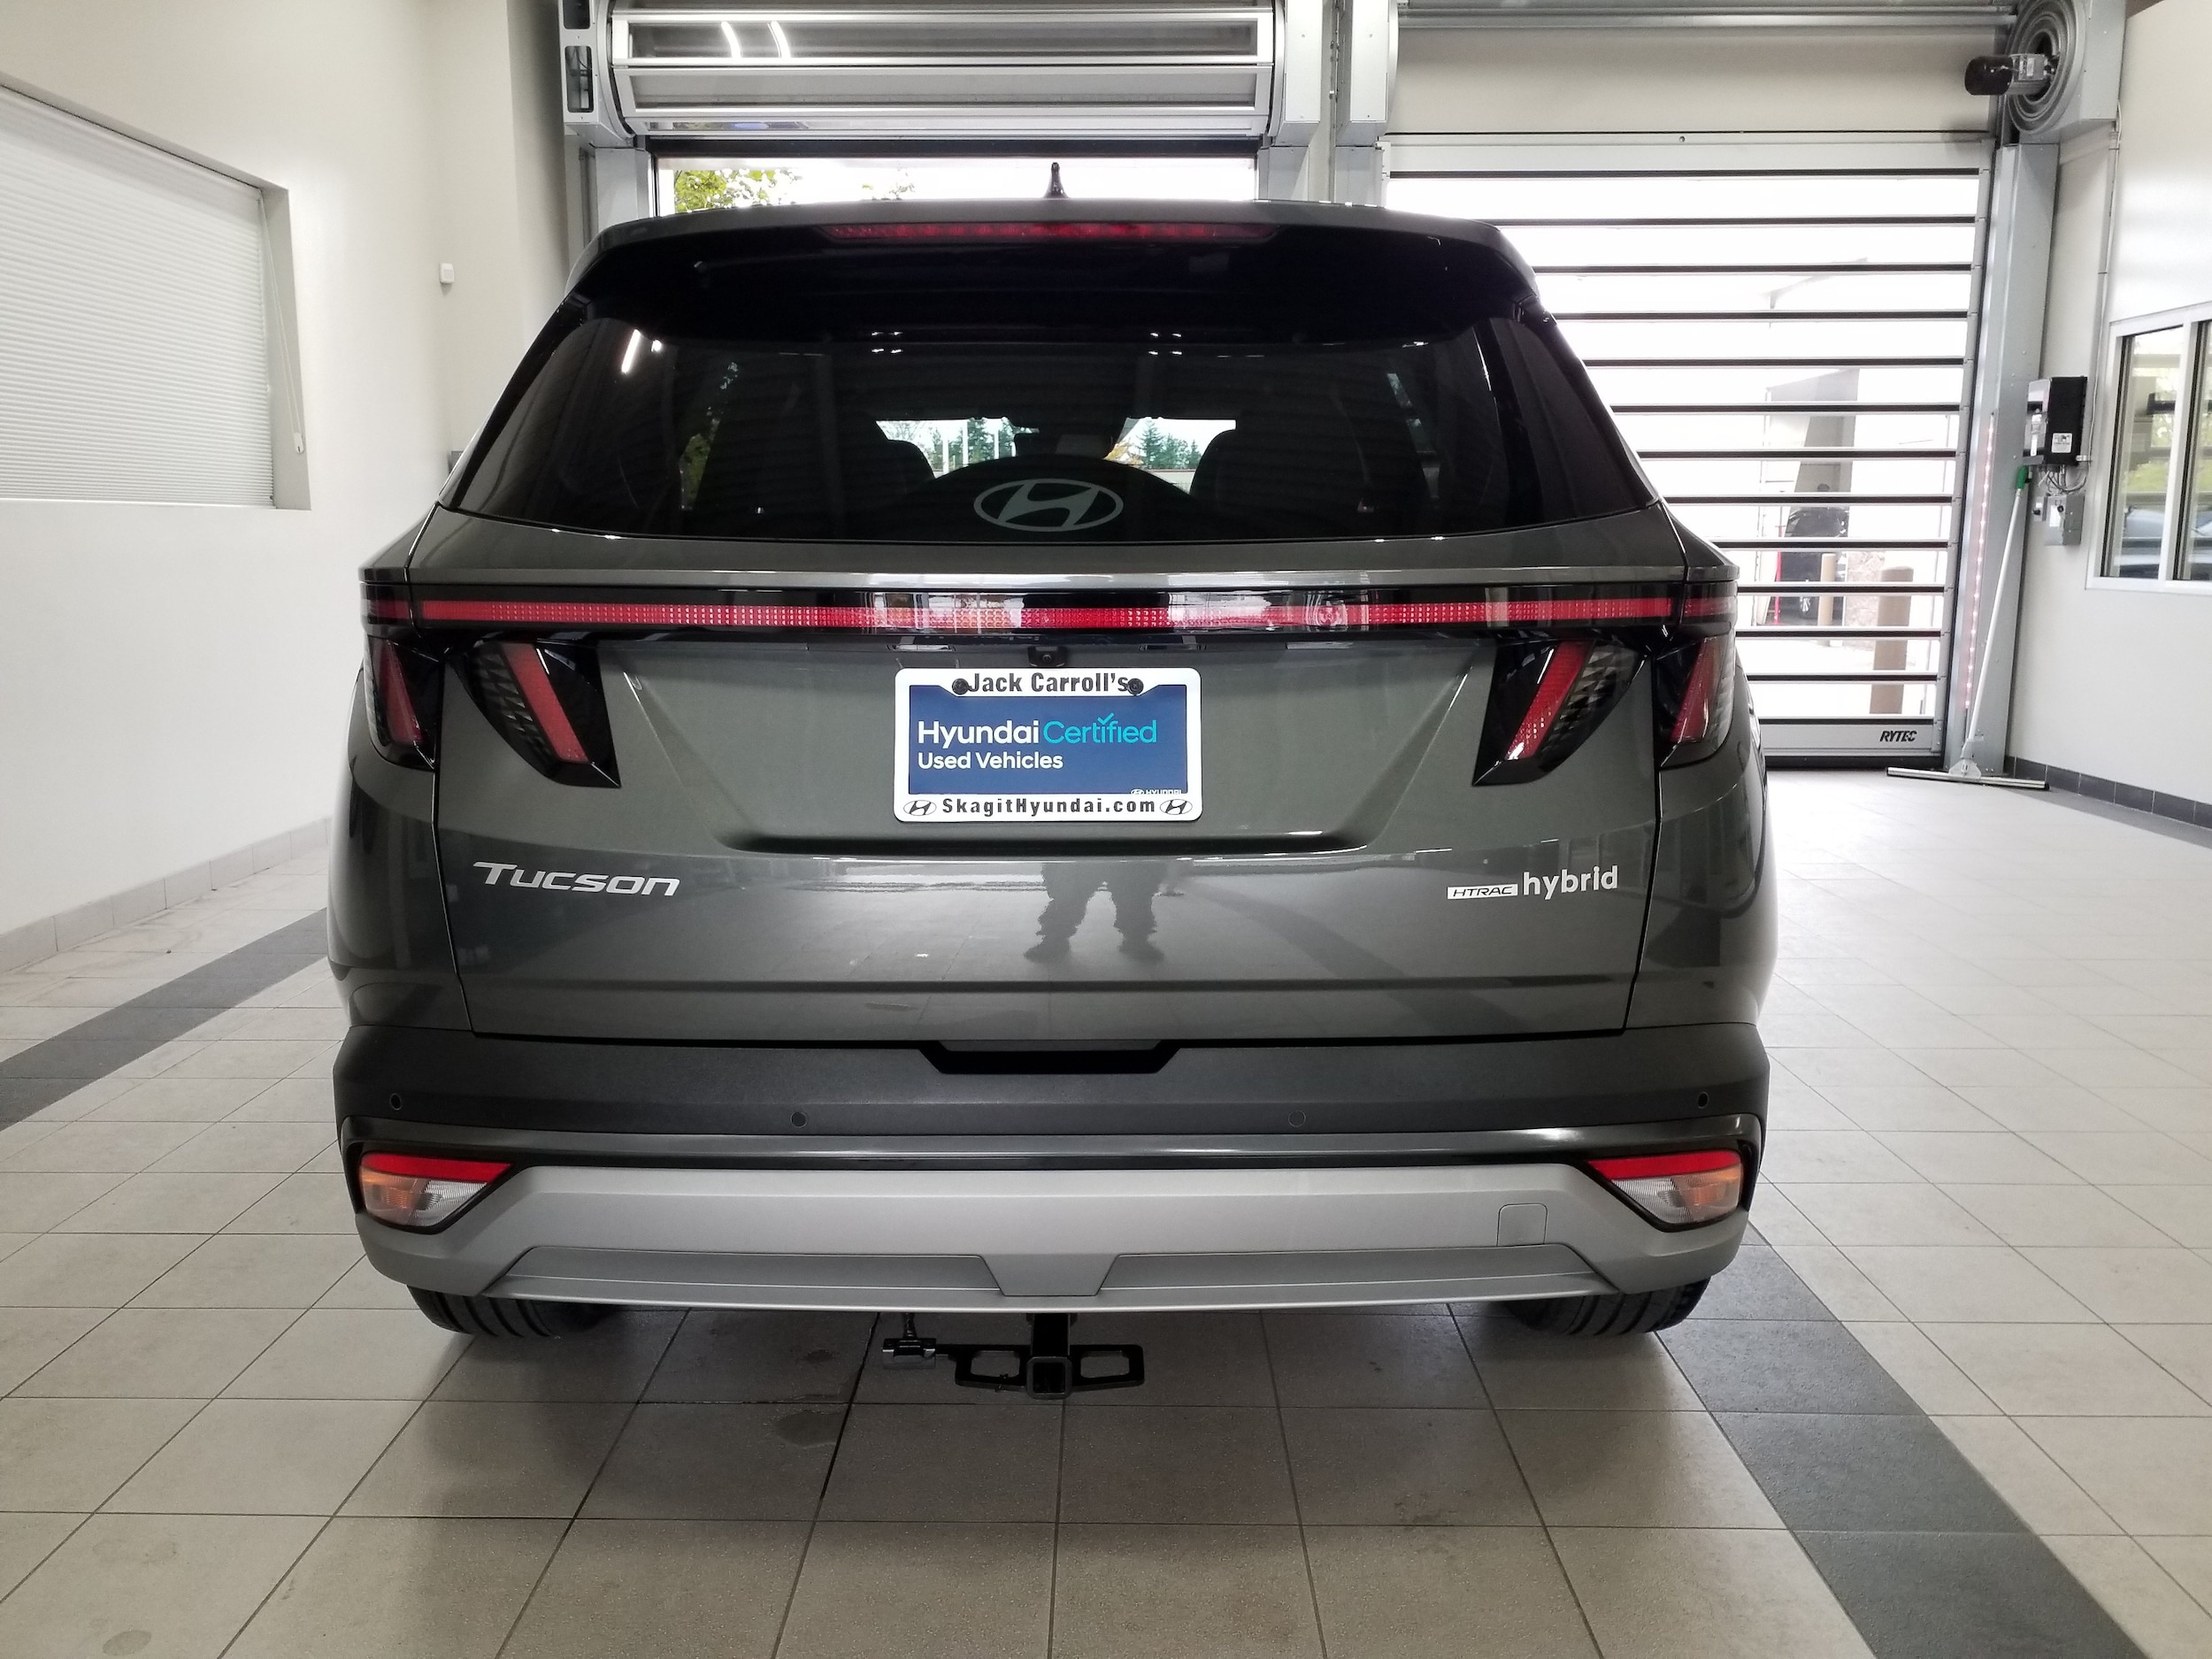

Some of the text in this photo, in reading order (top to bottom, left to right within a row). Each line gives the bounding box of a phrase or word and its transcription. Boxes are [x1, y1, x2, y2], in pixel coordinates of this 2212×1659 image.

[969, 672, 1129, 692] Jack Carroll's
[918, 712, 1157, 749] Hyundai Certified
[1879, 730, 1917, 742] RYTEC
[918, 751, 1064, 770] Used Vehicles
[942, 798, 1156, 817] SkagitHyundai.com
[1453, 864, 1618, 900] HTRAC hybrid
